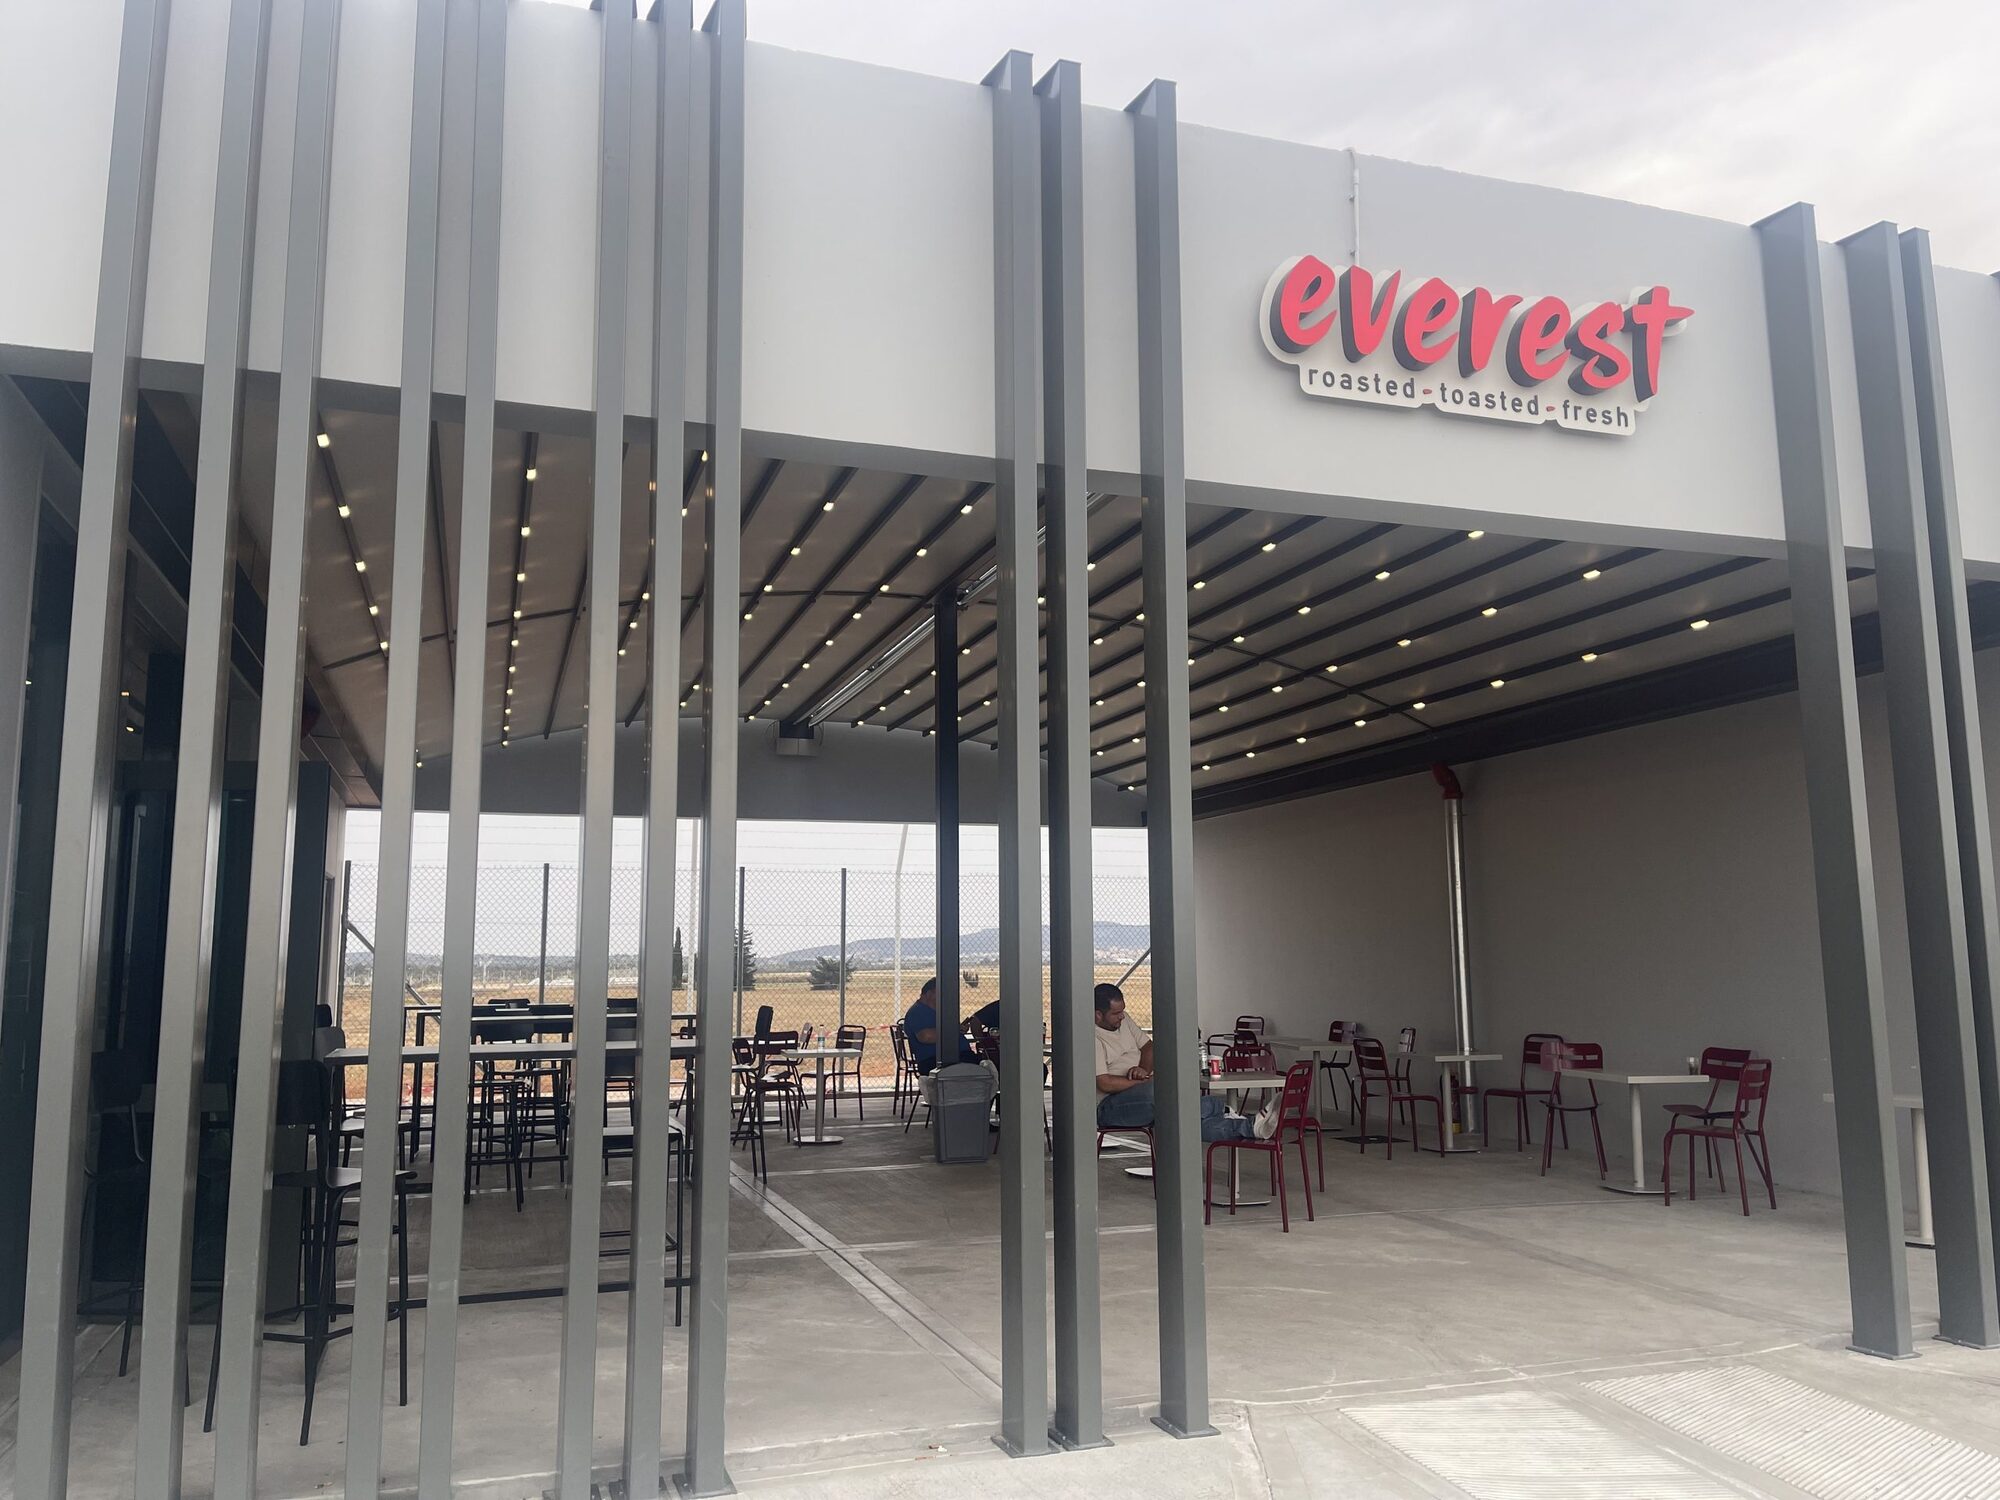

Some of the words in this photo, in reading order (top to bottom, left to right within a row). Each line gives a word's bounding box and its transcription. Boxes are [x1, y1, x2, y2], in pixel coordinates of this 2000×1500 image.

[1275, 254, 1695, 399] everest
[1308, 367, 1415, 399] roasted
[1440, 381, 1539, 416] toasted
[1562, 400, 1630, 427] fresh
